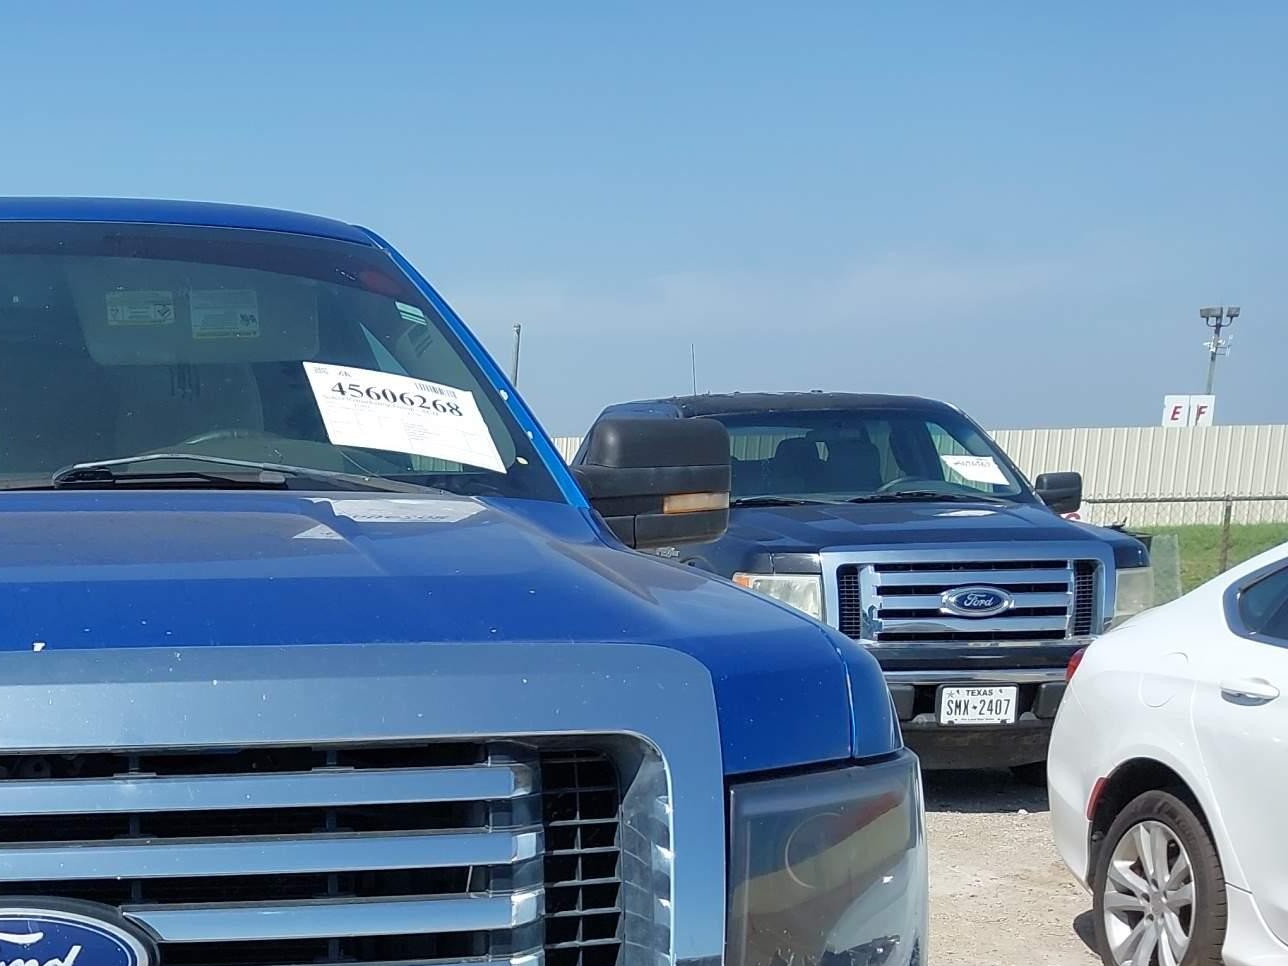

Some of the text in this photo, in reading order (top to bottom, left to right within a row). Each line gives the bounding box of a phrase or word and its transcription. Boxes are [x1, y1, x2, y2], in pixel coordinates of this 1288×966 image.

[330, 382, 464, 417] 45606268
[1170, 405, 1183, 421] E
[1196, 405, 1208, 424] F
[963, 593, 994, 608] Ford
[965, 688, 994, 697] TEXAS
